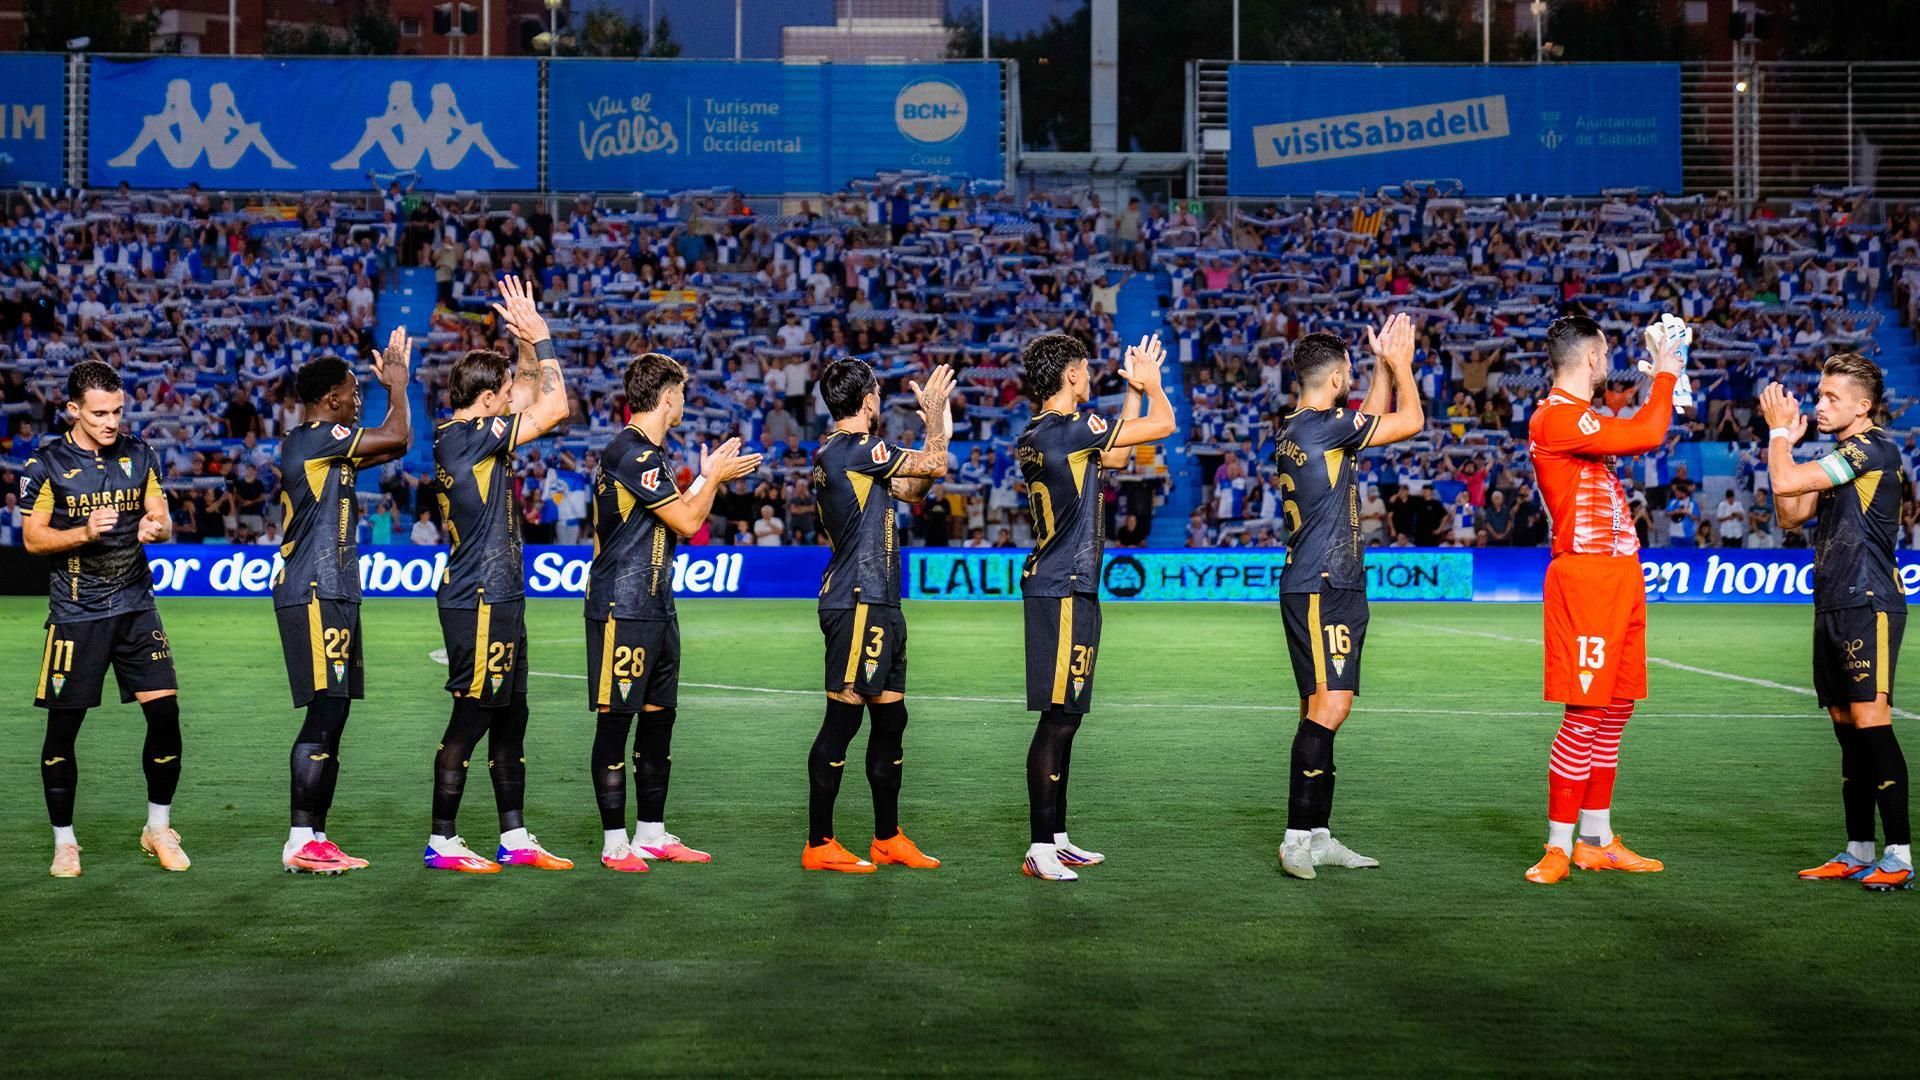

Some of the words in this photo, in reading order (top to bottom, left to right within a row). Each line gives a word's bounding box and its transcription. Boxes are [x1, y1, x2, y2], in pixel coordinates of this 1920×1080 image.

[704, 97, 780, 115] Turisme
[579, 114, 679, 161] Vallès
[704, 116, 760, 133] Vallès
[1272, 103, 1491, 157] visitSabadell
[1599, 132, 1657, 145] Sabadell
[703, 135, 801, 153] Occidental
[66, 487, 141, 507] BAHRAIN
[149, 558, 201, 592] or
[209, 551, 285, 592] del
[358, 551, 448, 592] tbol
[919, 558, 1014, 595] LALI
[1645, 561, 1691, 594] en
[1703, 555, 1815, 595] hono
[53, 639, 75, 672] 11
[324, 627, 351, 659] 22
[865, 625, 885, 658] 3
[1324, 624, 1352, 655] 16
[1576, 635, 1606, 669] 13
[487, 641, 515, 673] 23
[613, 645, 646, 677] 28
[1070, 644, 1094, 676] 30
